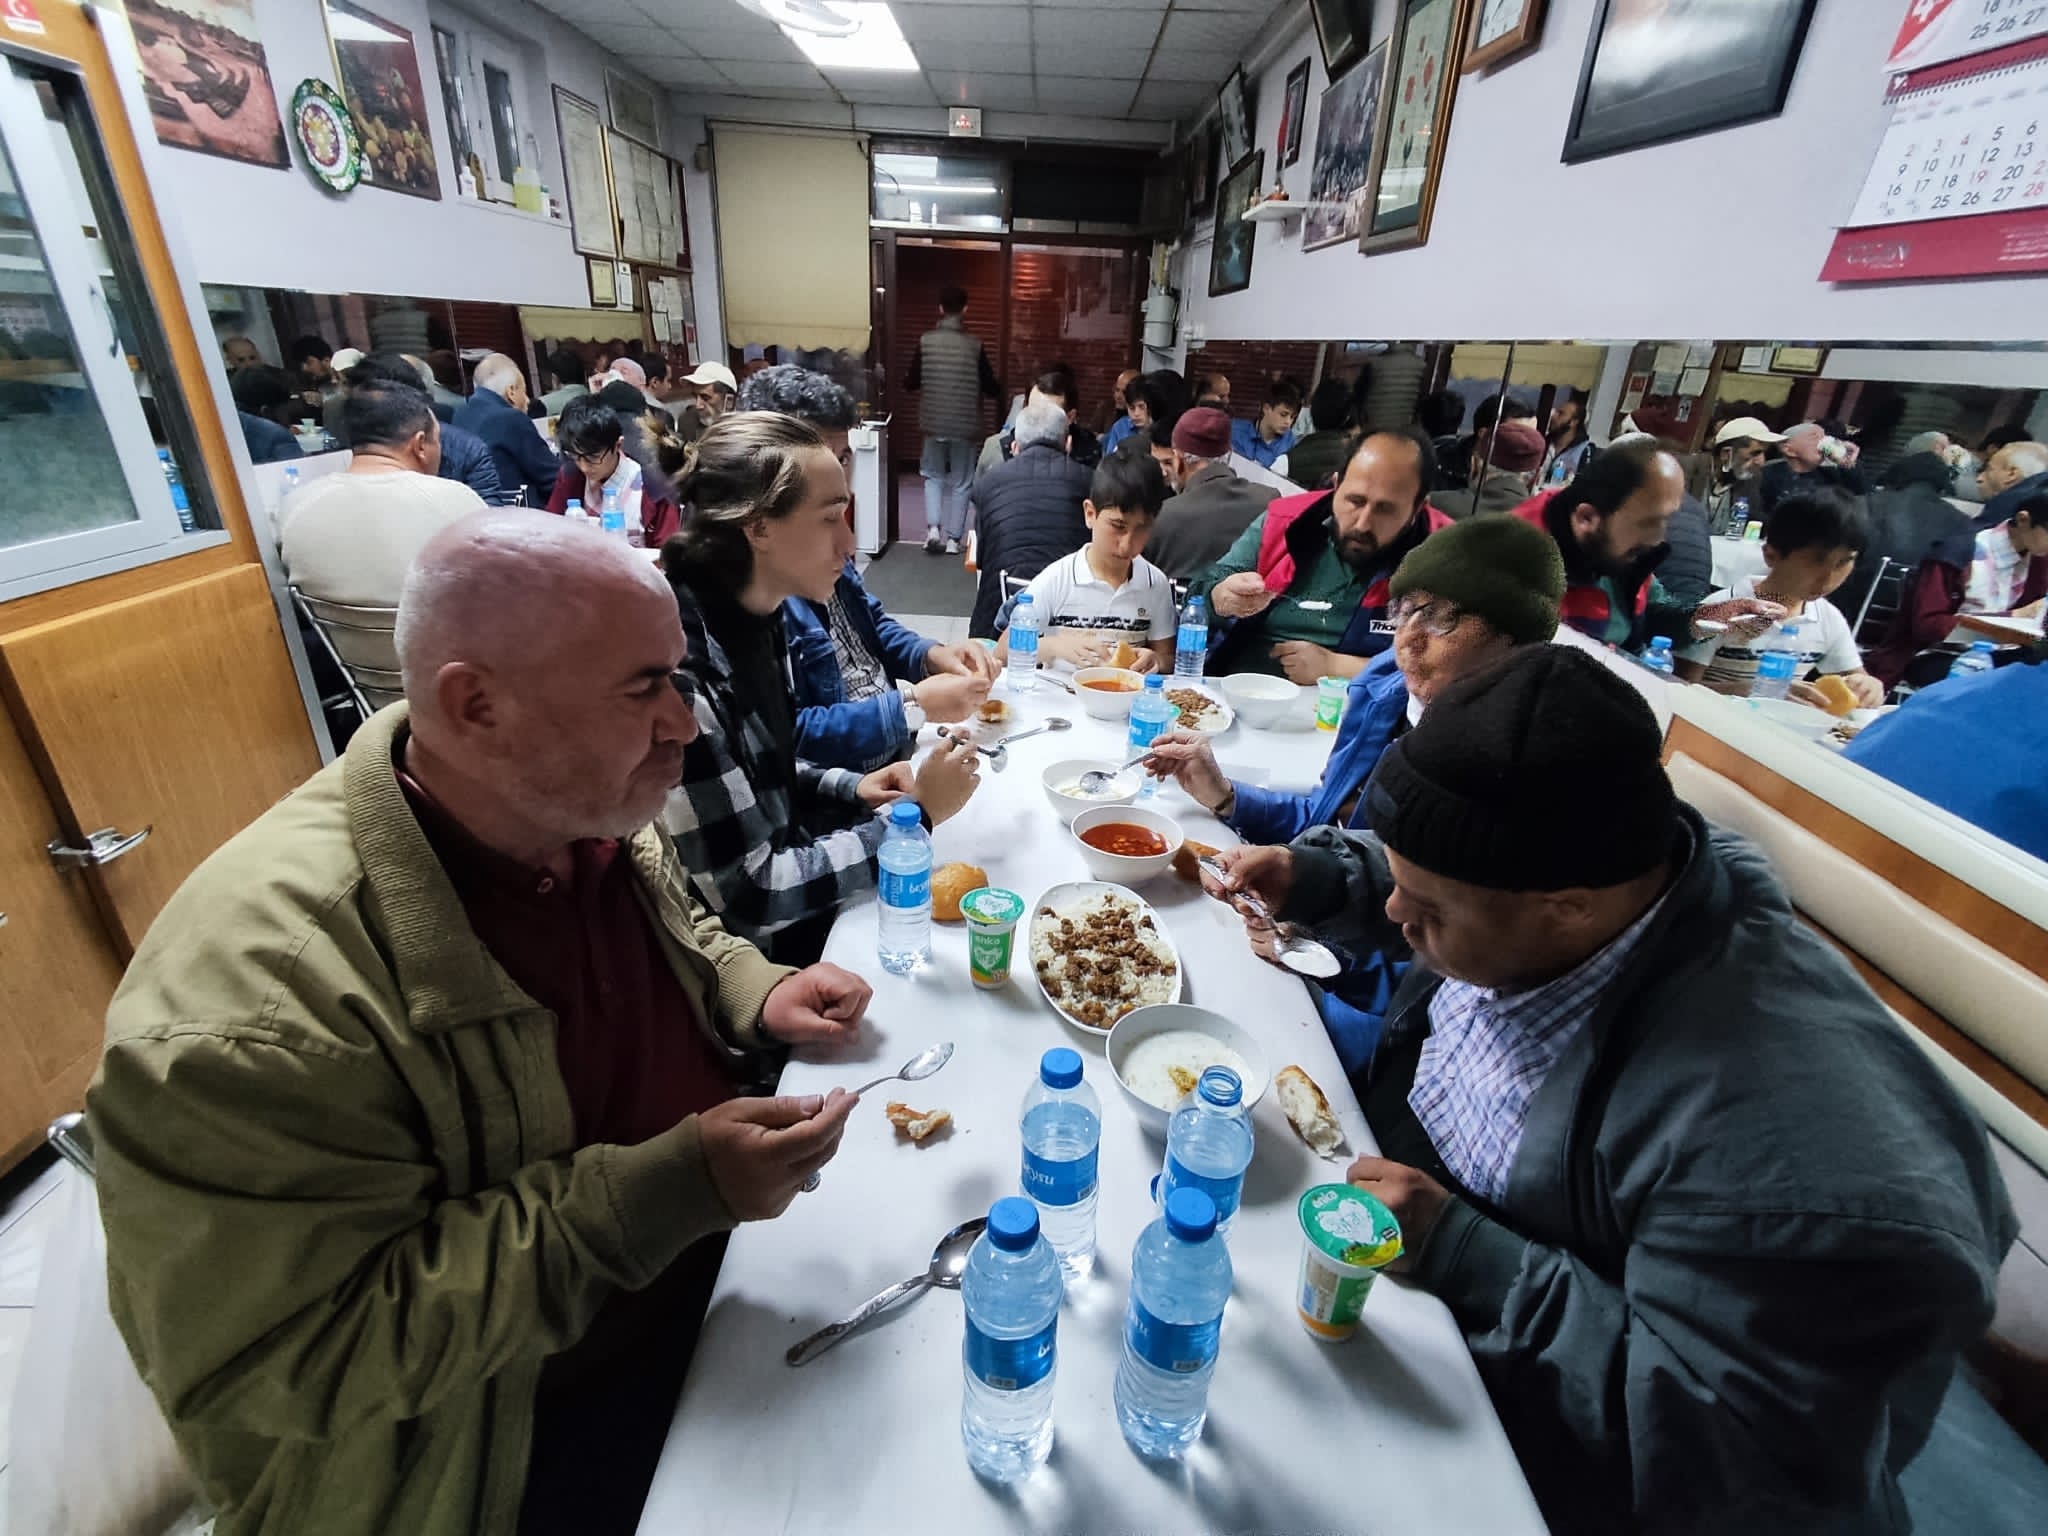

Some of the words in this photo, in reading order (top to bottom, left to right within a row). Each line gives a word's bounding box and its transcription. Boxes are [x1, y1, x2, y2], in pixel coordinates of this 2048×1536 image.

[1969, 22, 1991, 40] 25
[1995, 15, 2017, 33] 26
[2022, 6, 2047, 27] 27
[1992, 125, 2005, 141] 5
[2026, 119, 2039, 136] 6
[1897, 163, 1908, 176] 9
[1922, 158, 1939, 173] 10
[1950, 153, 1966, 169] 11
[1980, 146, 2001, 163] 12
[2013, 141, 2034, 158] 13
[1887, 183, 1902, 197] 16
[1914, 179, 1931, 193] 17
[1941, 173, 1959, 190] 18
[1969, 168, 1989, 184] 19
[2001, 164, 2025, 181] 20
[1931, 193, 1951, 209] 25
[1960, 190, 1981, 206] 26
[1991, 185, 2014, 202] 27
[2022, 180, 2046, 198] 28
